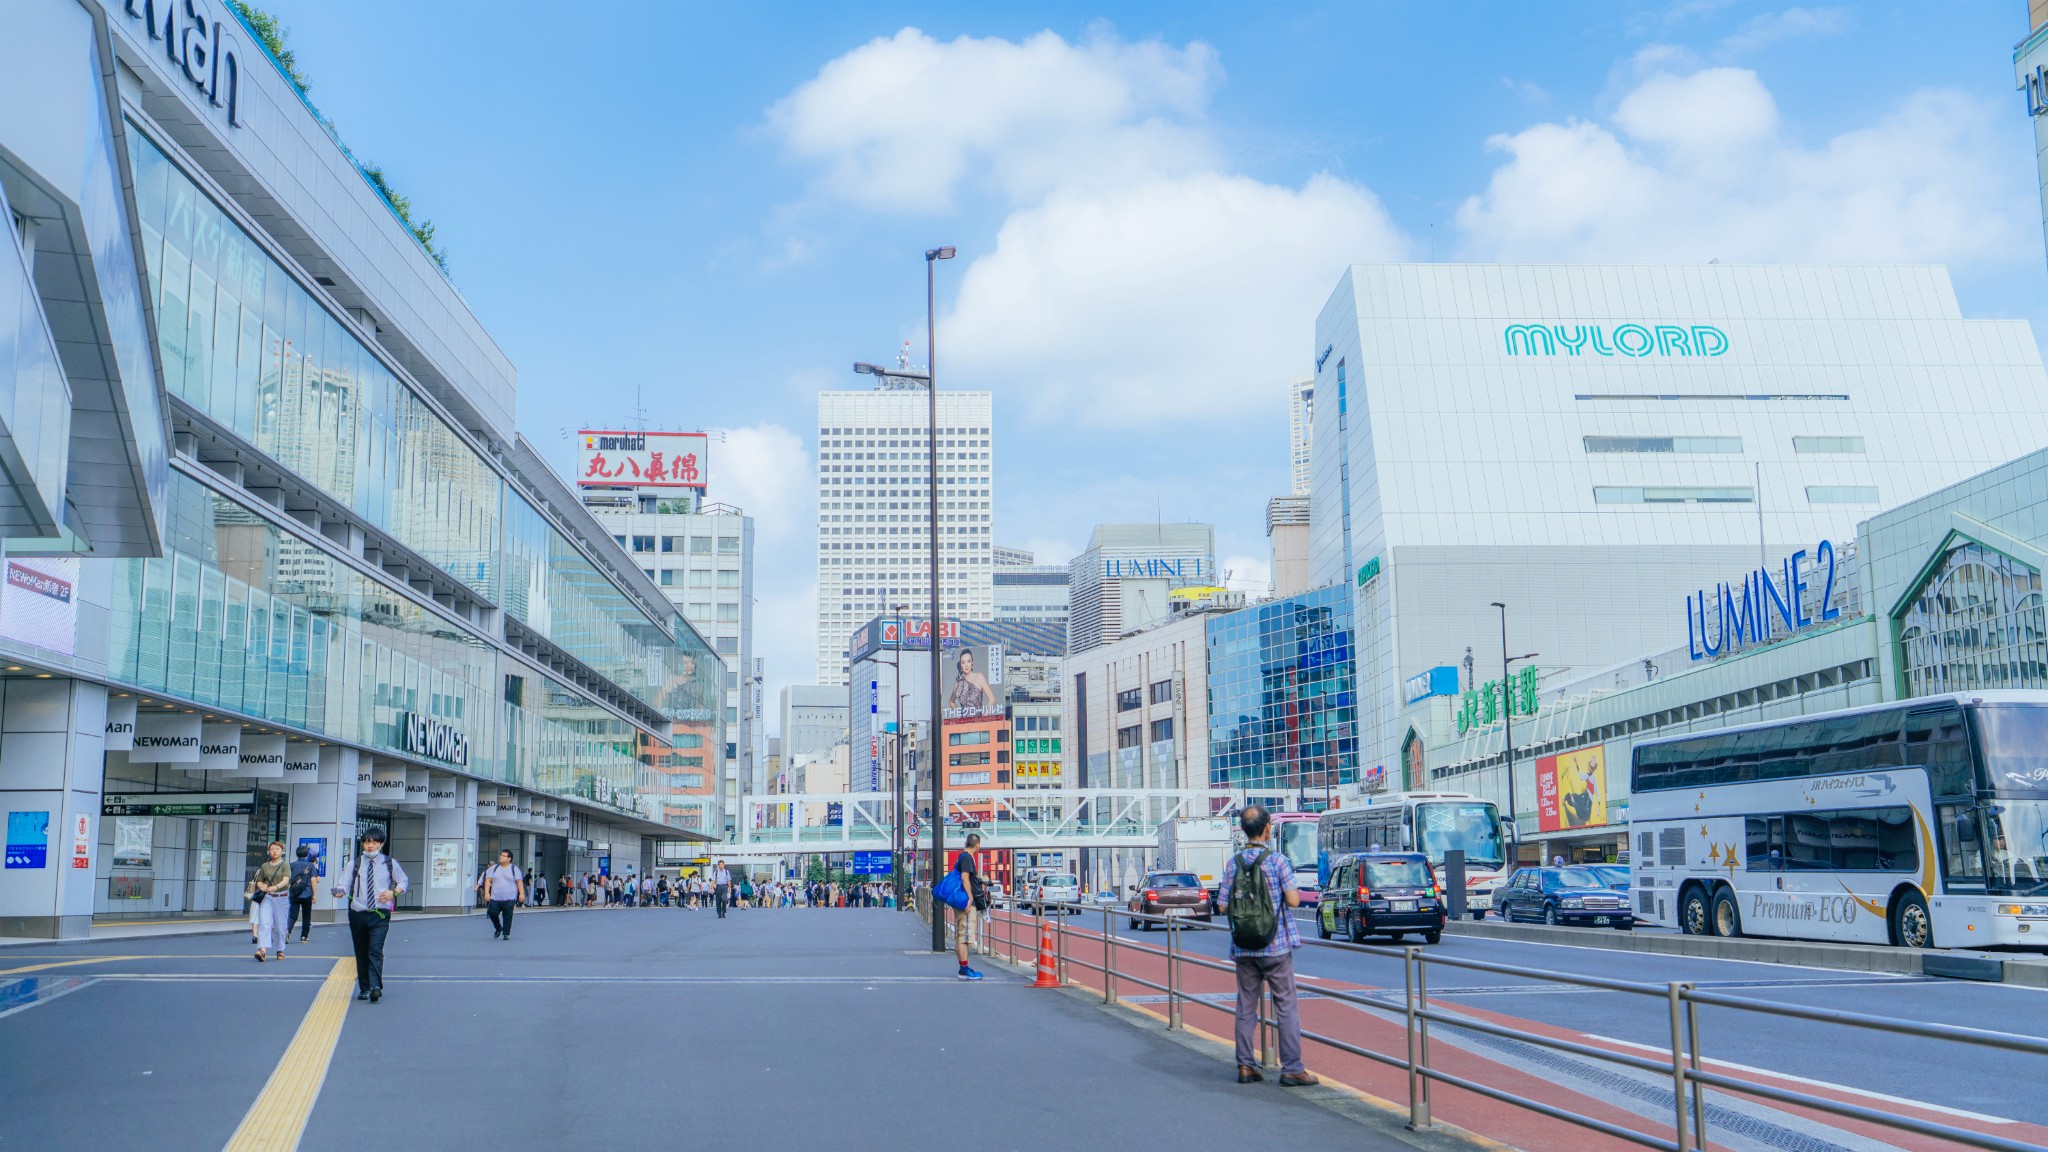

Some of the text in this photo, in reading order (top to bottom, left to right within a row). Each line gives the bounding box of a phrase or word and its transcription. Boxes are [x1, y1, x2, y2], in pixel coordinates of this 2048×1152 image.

[1504, 323, 1730, 358] MYLORD
[600, 432, 645, 451] maruhati
[1106, 558, 1201, 577] LUMINE 1
[1686, 540, 1840, 661] LUMINE 2
[905, 621, 957, 637] LABI
[943, 704, 1004, 718] THEグローバル社
[133, 736, 199, 747] NEWoMan
[406, 711, 469, 767] NEWoMan
[1016, 765, 1049, 774] 占い館
[1752, 895, 1857, 924] Premium ECO
